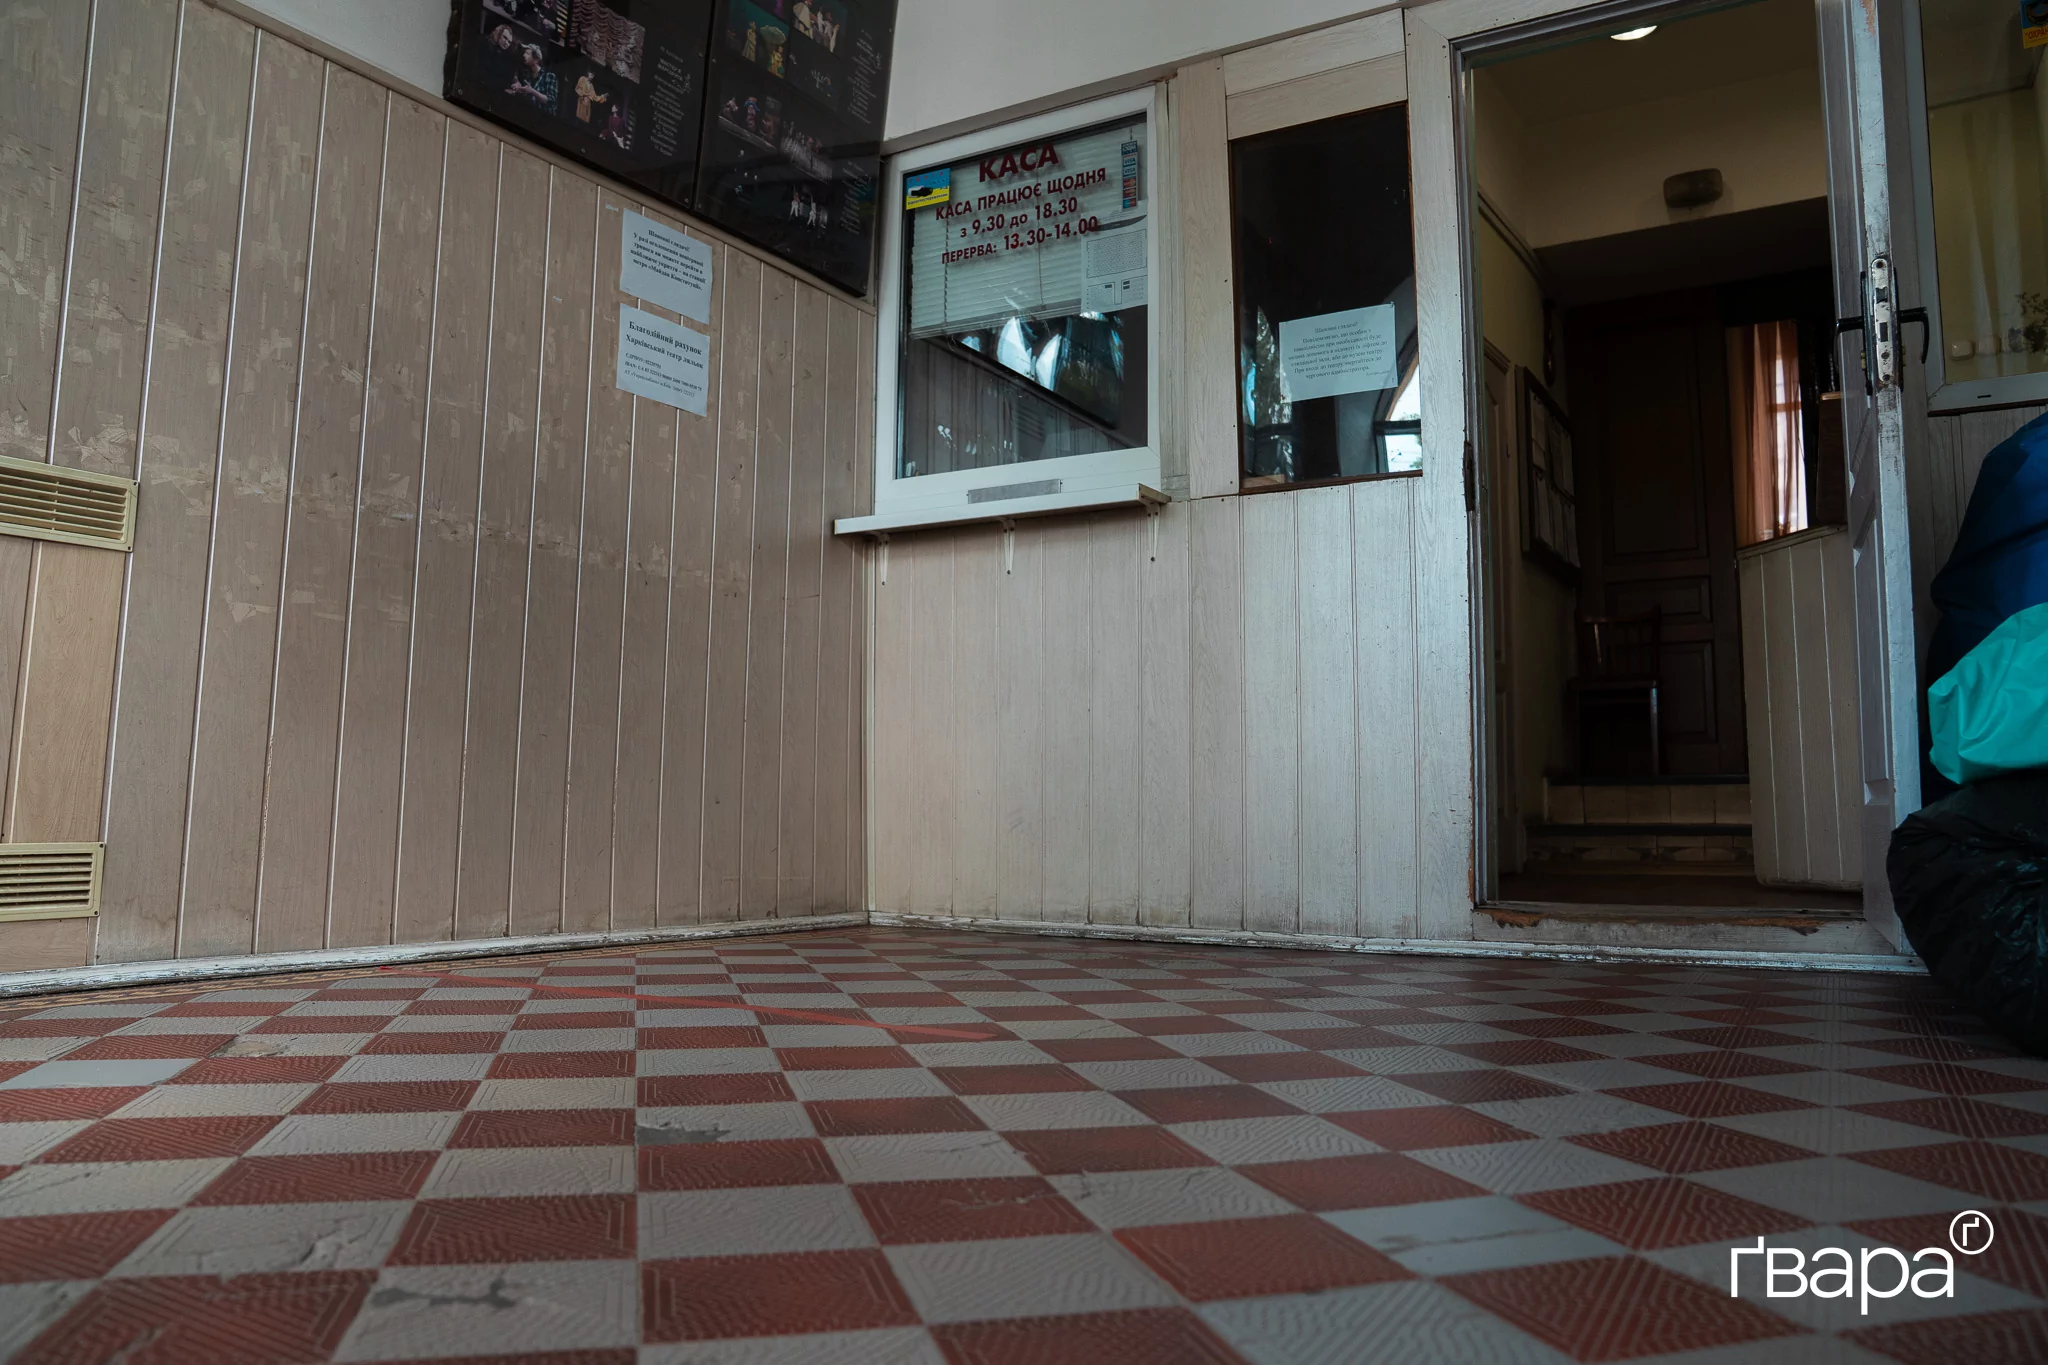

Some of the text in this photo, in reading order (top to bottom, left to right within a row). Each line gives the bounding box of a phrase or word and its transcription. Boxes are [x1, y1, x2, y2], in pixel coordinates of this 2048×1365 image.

[980, 143, 1059, 181] КАСА
[936, 201, 972, 220] КАСА
[978, 184, 1041, 210] ПРАЦЮЄ
[1048, 168, 1105, 193] ЩОДНЯ
[961, 197, 1077, 237] з 9.30 до 18.30
[942, 244, 996, 263] ПЕРЕРВА:
[626, 334, 703, 368] Харківський театр ляльок
[630, 321, 701, 355] Благодійний рахунок
